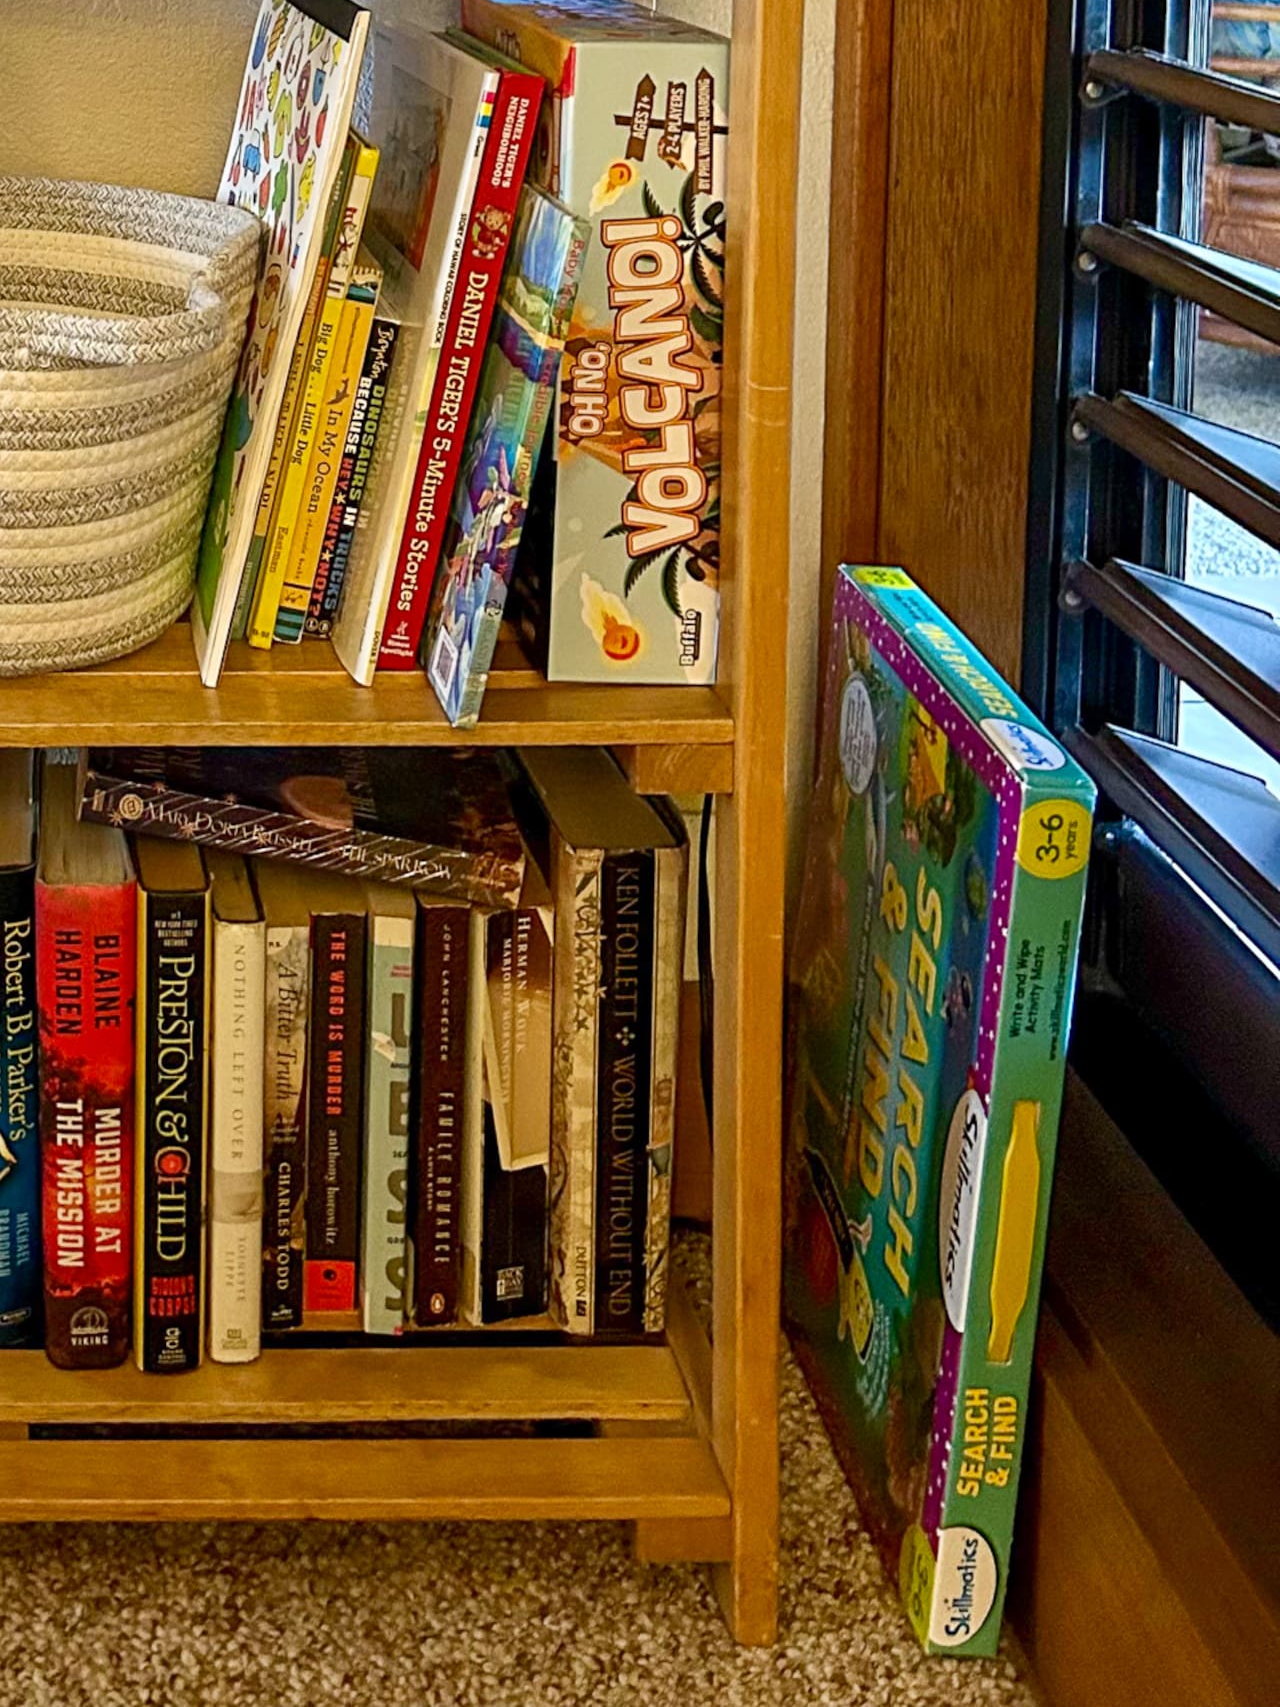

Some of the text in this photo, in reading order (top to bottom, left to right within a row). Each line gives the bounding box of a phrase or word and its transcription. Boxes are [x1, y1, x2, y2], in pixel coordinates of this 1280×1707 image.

[492, 95, 520, 187] NEIGHBORHOOD
[502, 97, 530, 188] DANIEL TIGER'S
[632, 95, 651, 140] AGES 7+
[667, 87, 685, 132] PLAYERS
[292, 322, 333, 465] Big Dog Little Dog
[570, 391, 608, 436] OH
[601, 215, 708, 557] VOLCANO!
[307, 408, 344, 514] In My Ocean
[397, 271, 489, 612] DANIEL TIGER'S 5-Minute Stories
[324, 384, 385, 611] DINOSAURS IN TRUCKS
[270, 525, 289, 574] Eastman
[680, 608, 701, 666] Buffalo
[1035, 813, 1064, 864] 3-6
[1064, 820, 1078, 861] years
[55, 929, 82, 1035] HARDEN
[93, 934, 121, 1030] BLAINE
[277, 963, 298, 982] A
[501, 937, 512, 1006] MARJORIE
[516, 916, 531, 1054] HERMAN WOUK
[614, 867, 641, 1023] KEN FOLLETT
[1008, 938, 1032, 1038] Write and Wipe
[1025, 945, 1046, 1034] Activity Mats
[3, 917, 35, 1142] Robert B. Parker's
[231, 944, 246, 1160] NOTHING LEFT OVER
[276, 986, 299, 1043] Bitter
[326, 931, 346, 1116] THE WORD IS MURDER
[439, 970, 452, 1062] LANCHESTER
[859, 861, 908, 1199] & FIND
[154, 953, 196, 1262] PRESTON & CHILD
[276, 1047, 298, 1101] Truth
[884, 866, 942, 1296] SEARCH
[56, 1099, 85, 1268] THE MISSION
[95, 1107, 121, 1254] MURDER AT
[277, 1161, 292, 1237] CHARLES
[324, 1128, 342, 1245] anthony horowitz
[434, 1092, 456, 1263] FAMILY ROMANCE
[608, 1053, 637, 1317] WORLD WITHOUT END
[946, 1102, 979, 1292] Skillmatics
[16, 1212, 30, 1266] MICHAEL
[276, 1245, 291, 1291] TODD
[574, 1246, 588, 1302] DUTTON
[71, 1335, 109, 1346] VIKING
[149, 1297, 196, 1317] CORPSE
[957, 1388, 988, 1498] SEARCH
[985, 1396, 1017, 1487] & FIND
[945, 1537, 980, 1636] Skillmatics
